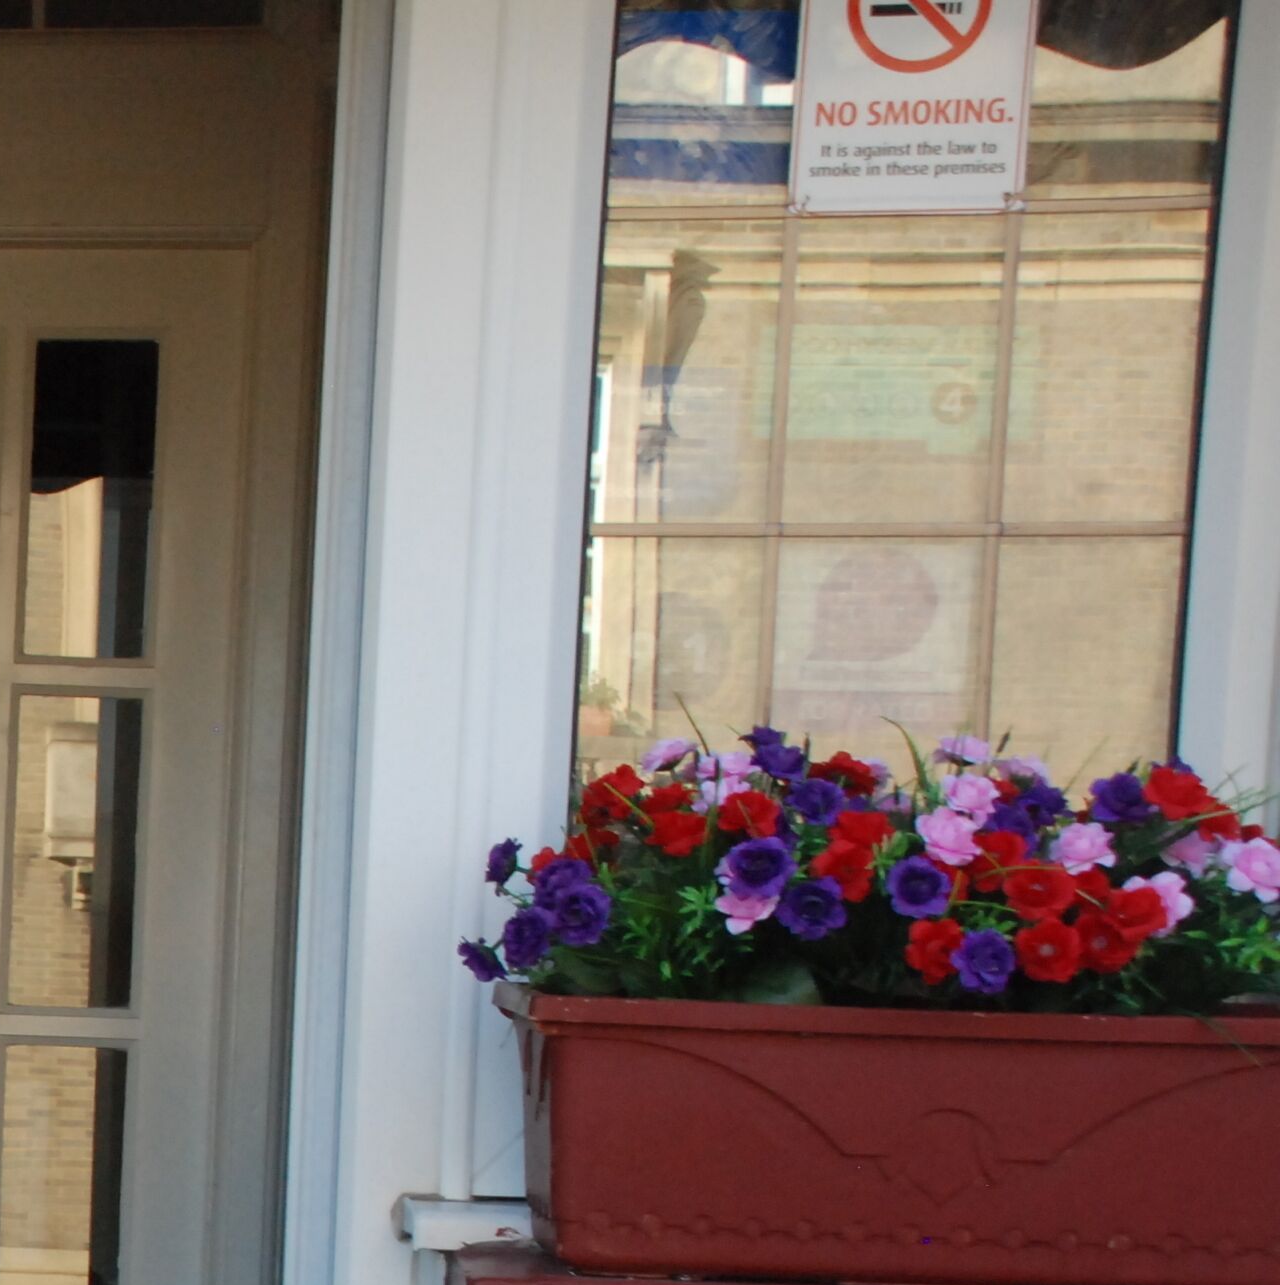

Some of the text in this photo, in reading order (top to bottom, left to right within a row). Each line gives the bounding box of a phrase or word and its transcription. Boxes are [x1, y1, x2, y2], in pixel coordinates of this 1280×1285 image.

[814, 98, 1014, 127] NO SMOKING.
[820, 141, 997, 160] It is against the law to
[809, 161, 1006, 178] smoke in these premises
